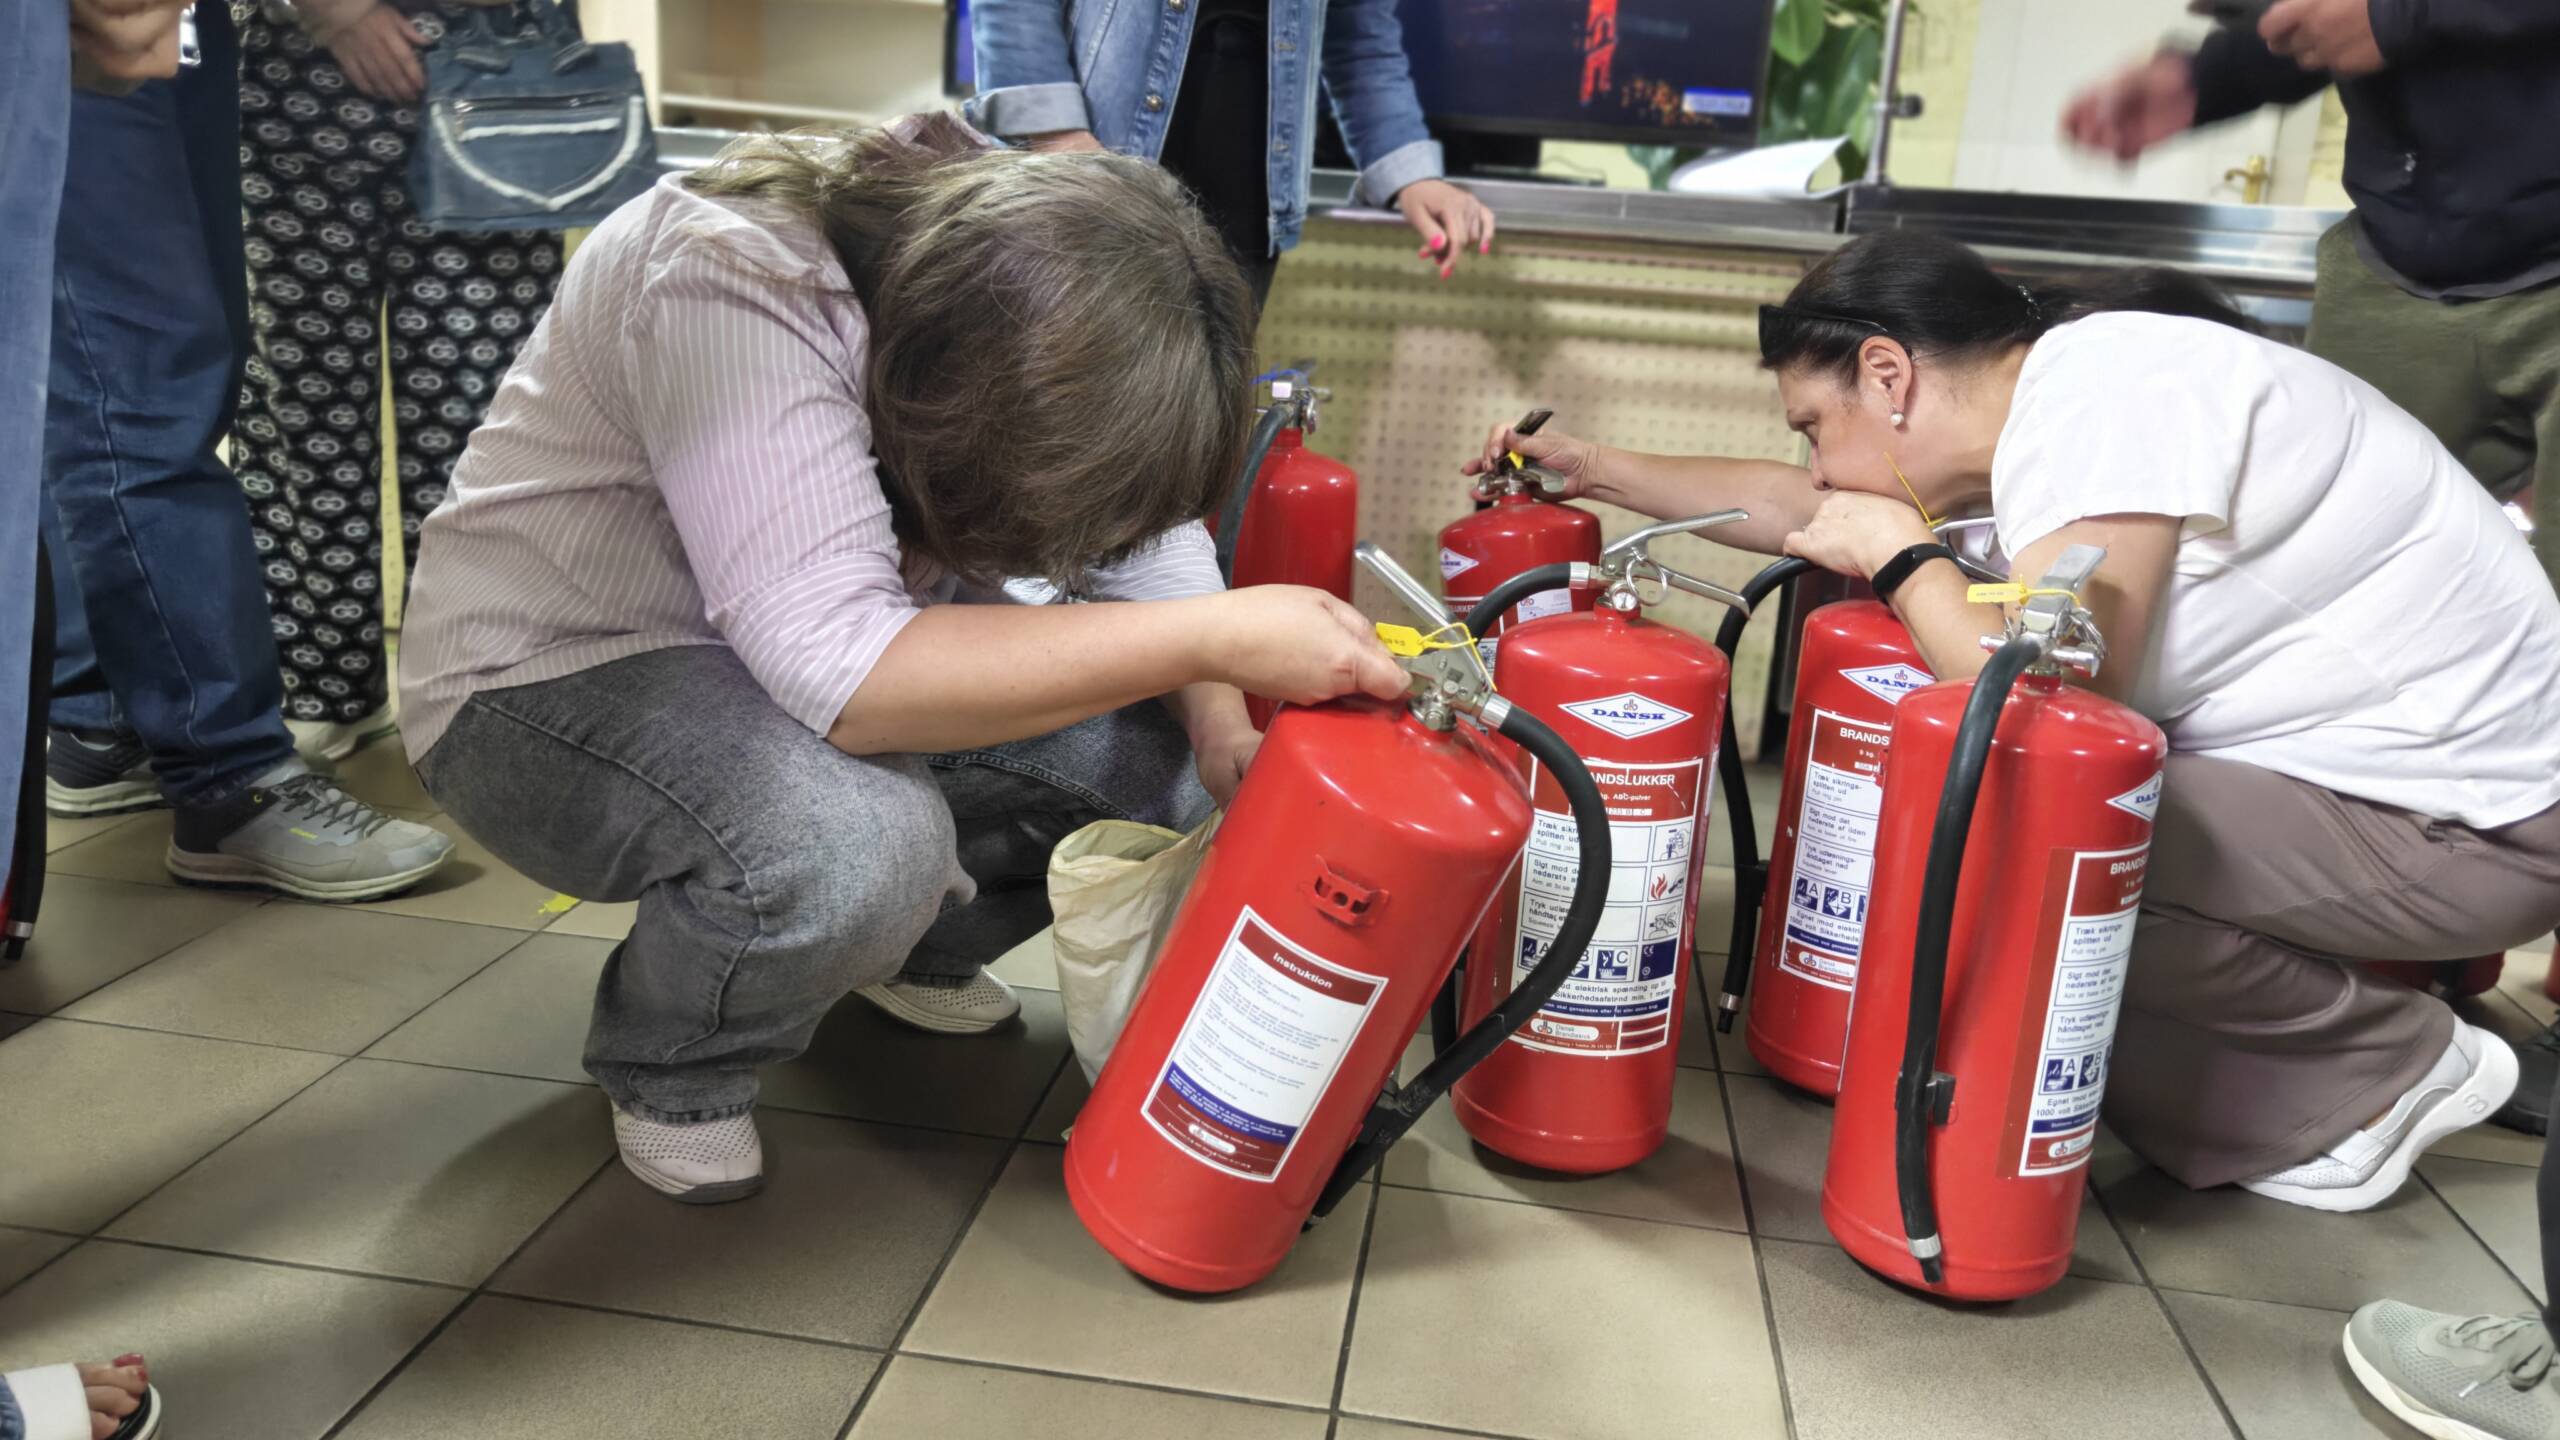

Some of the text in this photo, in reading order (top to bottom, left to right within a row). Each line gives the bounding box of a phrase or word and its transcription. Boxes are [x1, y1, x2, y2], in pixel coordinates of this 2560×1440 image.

[1866, 674, 1921, 688] DANS
[1591, 708, 1666, 720] DANSK
[1840, 727, 1889, 746] BRANDS
[1538, 820, 1578, 834] Træk sikr
[1809, 883, 1818, 896] A
[1841, 892, 1852, 904] B
[1617, 950, 1629, 964] C
[1273, 952, 1332, 990] Instruktion
[2064, 1058, 2076, 1073] A
